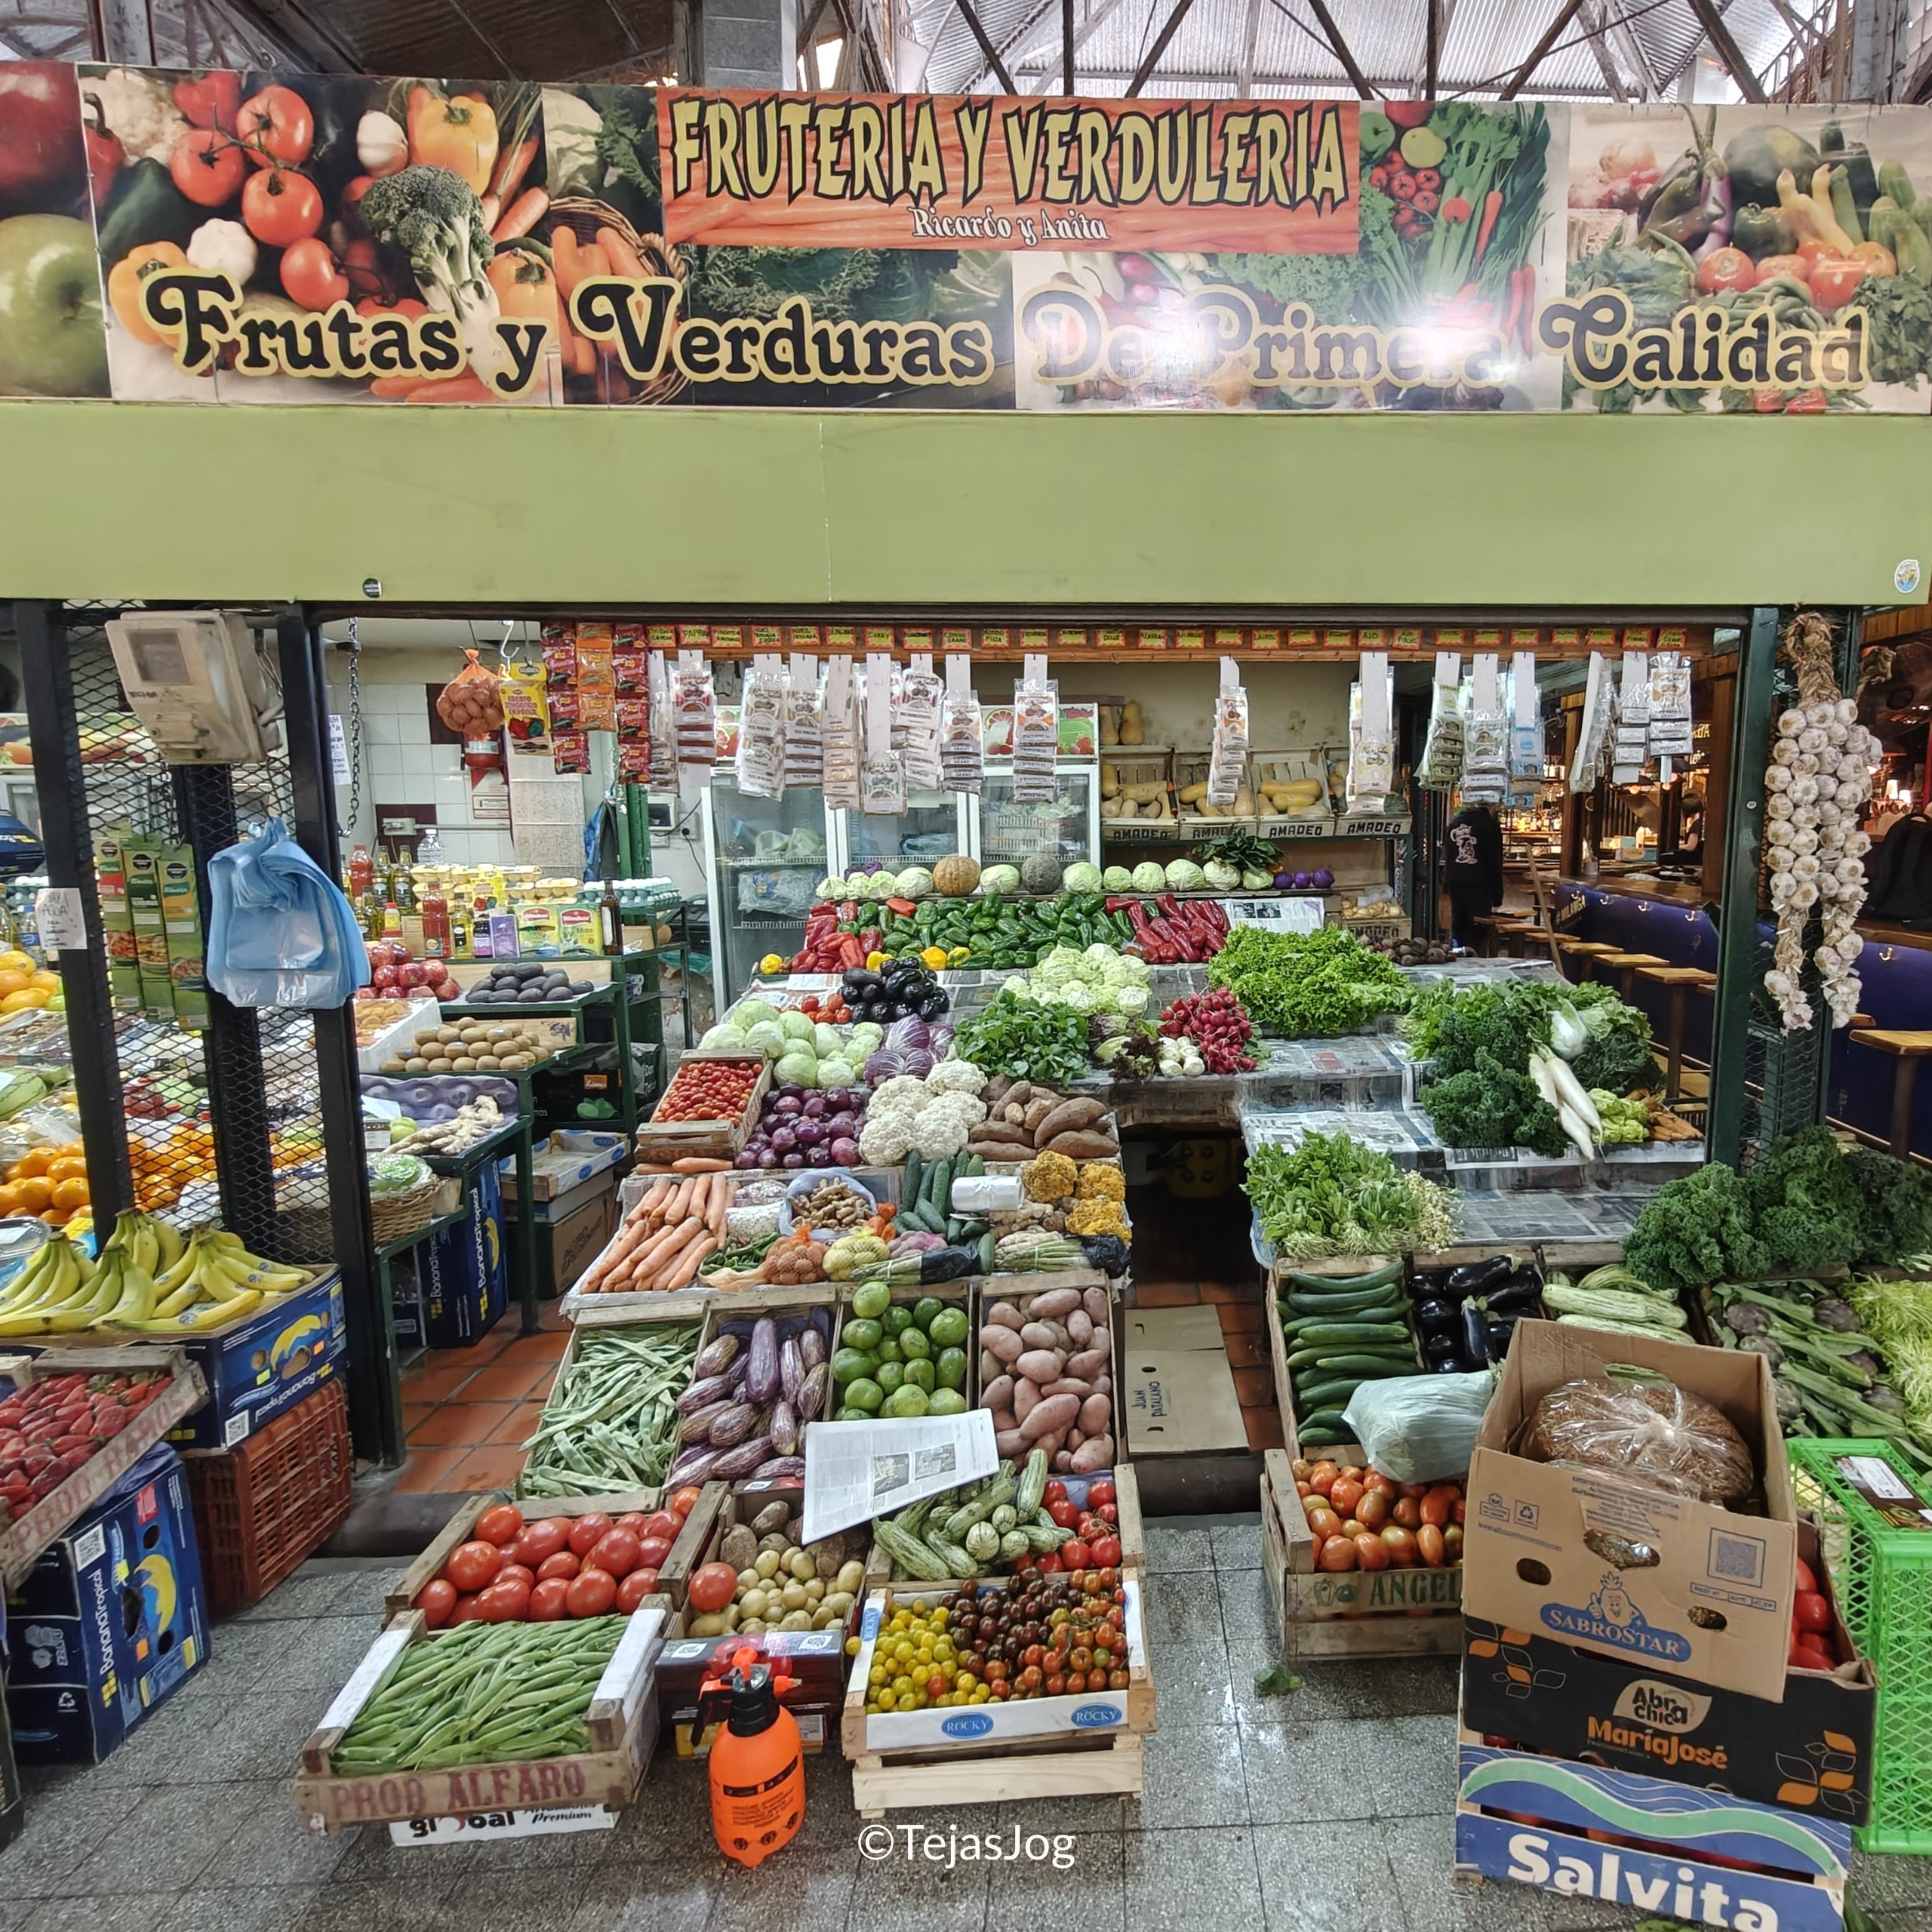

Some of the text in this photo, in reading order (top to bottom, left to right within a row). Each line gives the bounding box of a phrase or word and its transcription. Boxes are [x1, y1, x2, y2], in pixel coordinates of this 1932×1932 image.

[671, 93, 1350, 217] FRUTERIA Y VERDULERIA
[909, 205, 1111, 247] Ricardo y Anita
[145, 273, 461, 371] Frutas
[495, 323, 548, 394] y
[576, 282, 988, 379] Verduras
[1022, 291, 1149, 380] De
[1538, 294, 1866, 383] Calidad
[1113, 829, 1168, 841] AMADEO
[1269, 825, 1323, 838] AMADEO
[1346, 821, 1401, 835] AMADEO
[469, 1187, 488, 1288] BananaTropical
[254, 1371, 316, 1423] BananaTropical
[1131, 1389, 1146, 1410] JUAN
[1149, 1380, 1168, 1417] PATALANO
[88, 1567, 115, 1675] BananaTropical
[1549, 1609, 1681, 1658] SABROSTAR
[946, 1718, 991, 1732] ROCKY
[1076, 1709, 1119, 1722] ROCKY
[1587, 1715, 1728, 1770] MaríaJosé
[330, 1761, 586, 1820] PROD ALFARO
[531, 1810, 593, 1825] Premium
[1507, 1832, 1780, 1932] Salvita
